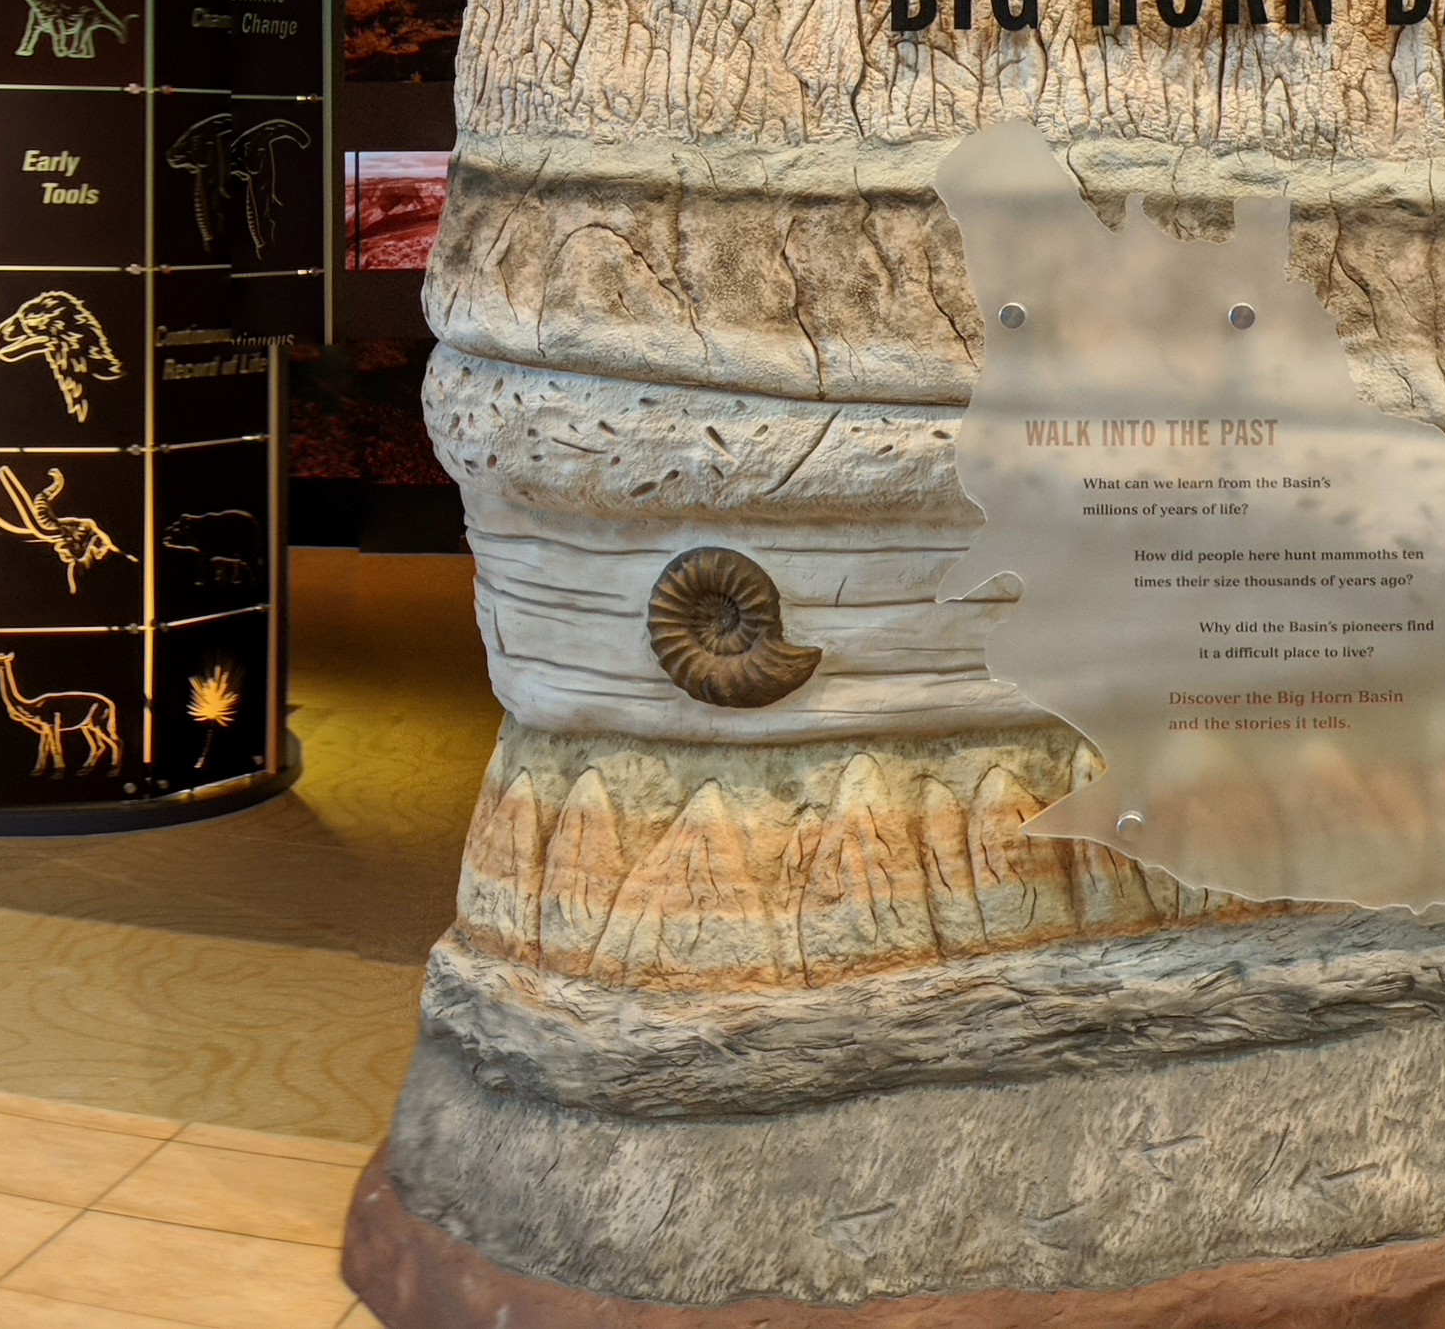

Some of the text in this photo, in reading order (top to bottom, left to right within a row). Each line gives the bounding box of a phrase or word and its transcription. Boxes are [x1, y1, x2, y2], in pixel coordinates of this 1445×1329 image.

[242, 12, 298, 39] Change
[22, 150, 80, 177] Early
[41, 182, 100, 204] Tools
[1025, 419, 1278, 446] WALK INTO THE PAST
[1083, 477, 1120, 490] What
[1124, 480, 1149, 489] can
[1153, 480, 1173, 489] we
[1177, 477, 1213, 490] learn
[1218, 476, 1251, 489] from
[1256, 477, 1278, 489] the
[1082, 503, 1249, 518] millions of years of life?
[1134, 548, 1424, 564] How did people here hunt mammoths ten
[1134, 574, 1414, 589] times their size thousands of years ago?
[1199, 621, 1231, 635] Why
[1235, 621, 1258, 633] did
[1262, 621, 1284, 633] the
[1342, 621, 1403, 634] pioneers
[1407, 620, 1435, 632] find
[1199, 646, 1374, 661] it a difficult place to live?
[1169, 689, 1404, 706] Discover the Big Horn Basin
[1168, 716, 1351, 731] and the stories it tells.
